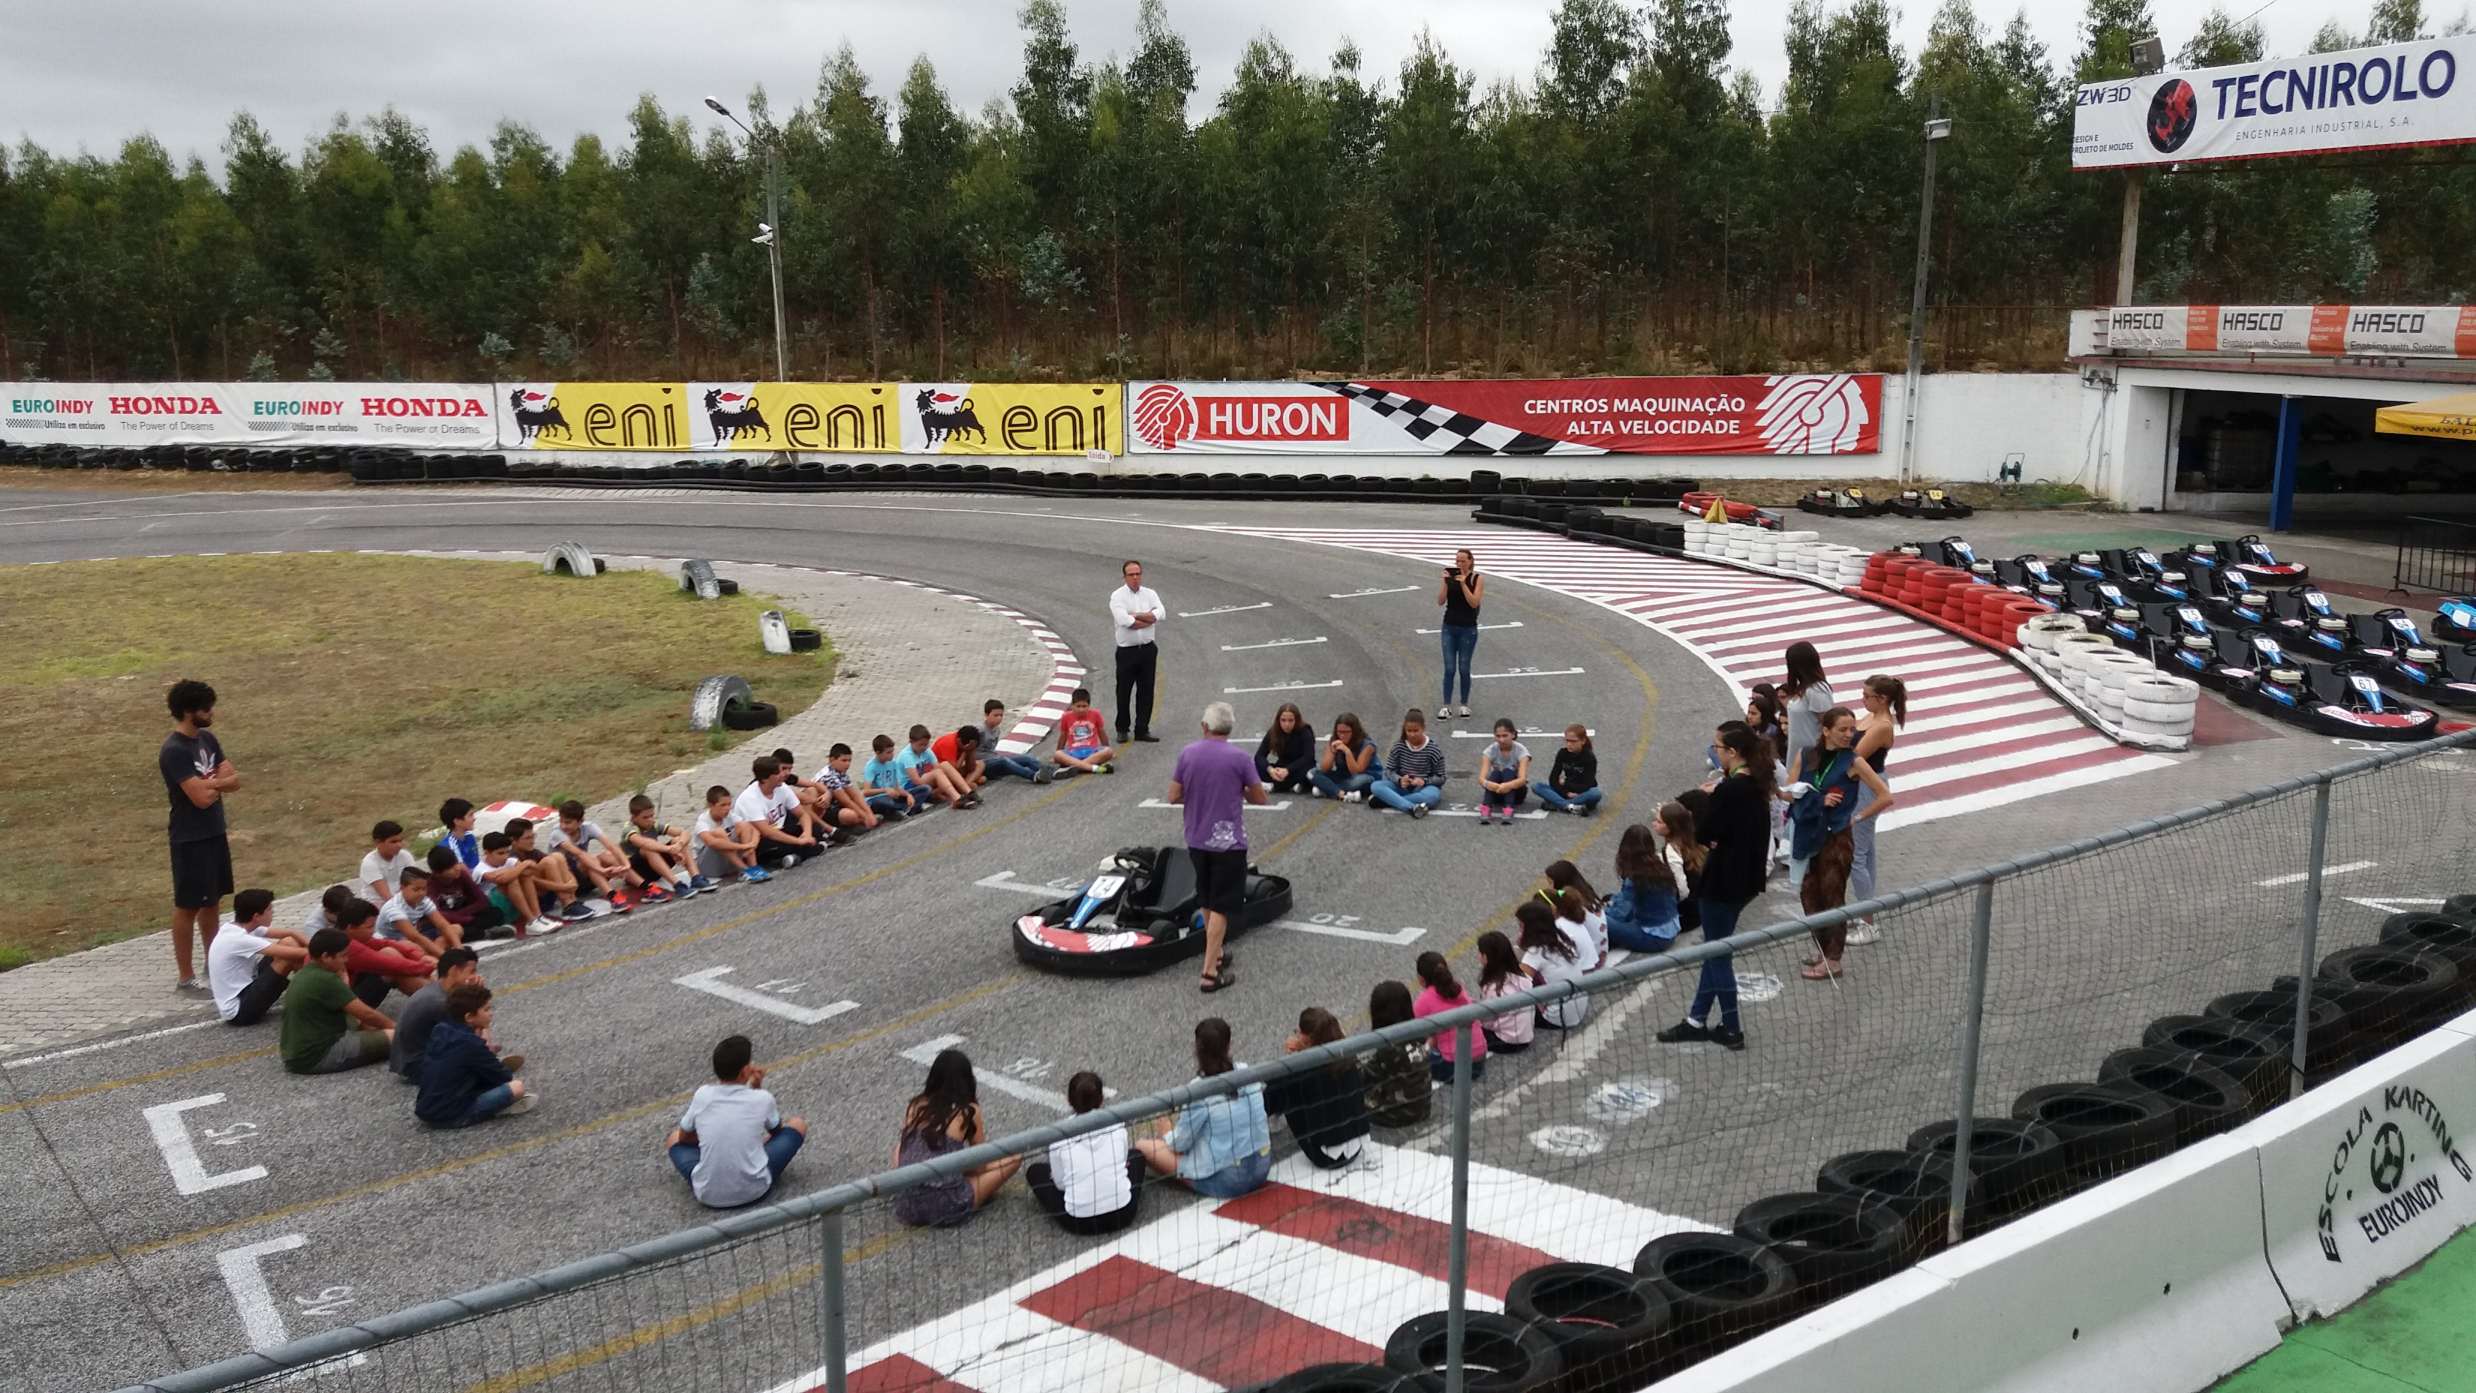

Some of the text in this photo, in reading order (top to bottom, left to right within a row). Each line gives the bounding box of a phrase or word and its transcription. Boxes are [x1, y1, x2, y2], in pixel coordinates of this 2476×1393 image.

[2212, 49, 2456, 120] TECNIROLO
[2076, 86, 2131, 106] ZW3D
[2236, 126, 2306, 141] ENGENHARIA
[2099, 144, 2108, 152] DE
[2108, 142, 2134, 151] MOLDES
[2112, 313, 2163, 330] HASCO
[2223, 313, 2283, 331] HASCO
[2352, 313, 2426, 333] HASCO
[12, 399, 94, 413] EUROINDY
[108, 397, 223, 414] HONDA
[253, 400, 345, 415] EUROINDY
[360, 398, 488, 417] HONDA
[1524, 393, 1746, 416] CENTROS MAQUINAÇÃO
[121, 421, 214, 431] The Power of Dreams
[584, 387, 677, 447] eni
[784, 388, 886, 448] eni
[1001, 388, 1106, 451] eni
[1209, 402, 1337, 435] HURON
[374, 423, 392, 433] The
[396, 423, 427, 434] Power
[441, 424, 481, 434] Dreams
[1567, 419, 1740, 435] ALTA VELOCIDADE
[2318, 1085, 2473, 1263] ESCOLA KARTING
[2358, 1173, 2444, 1244] EUROINDY
